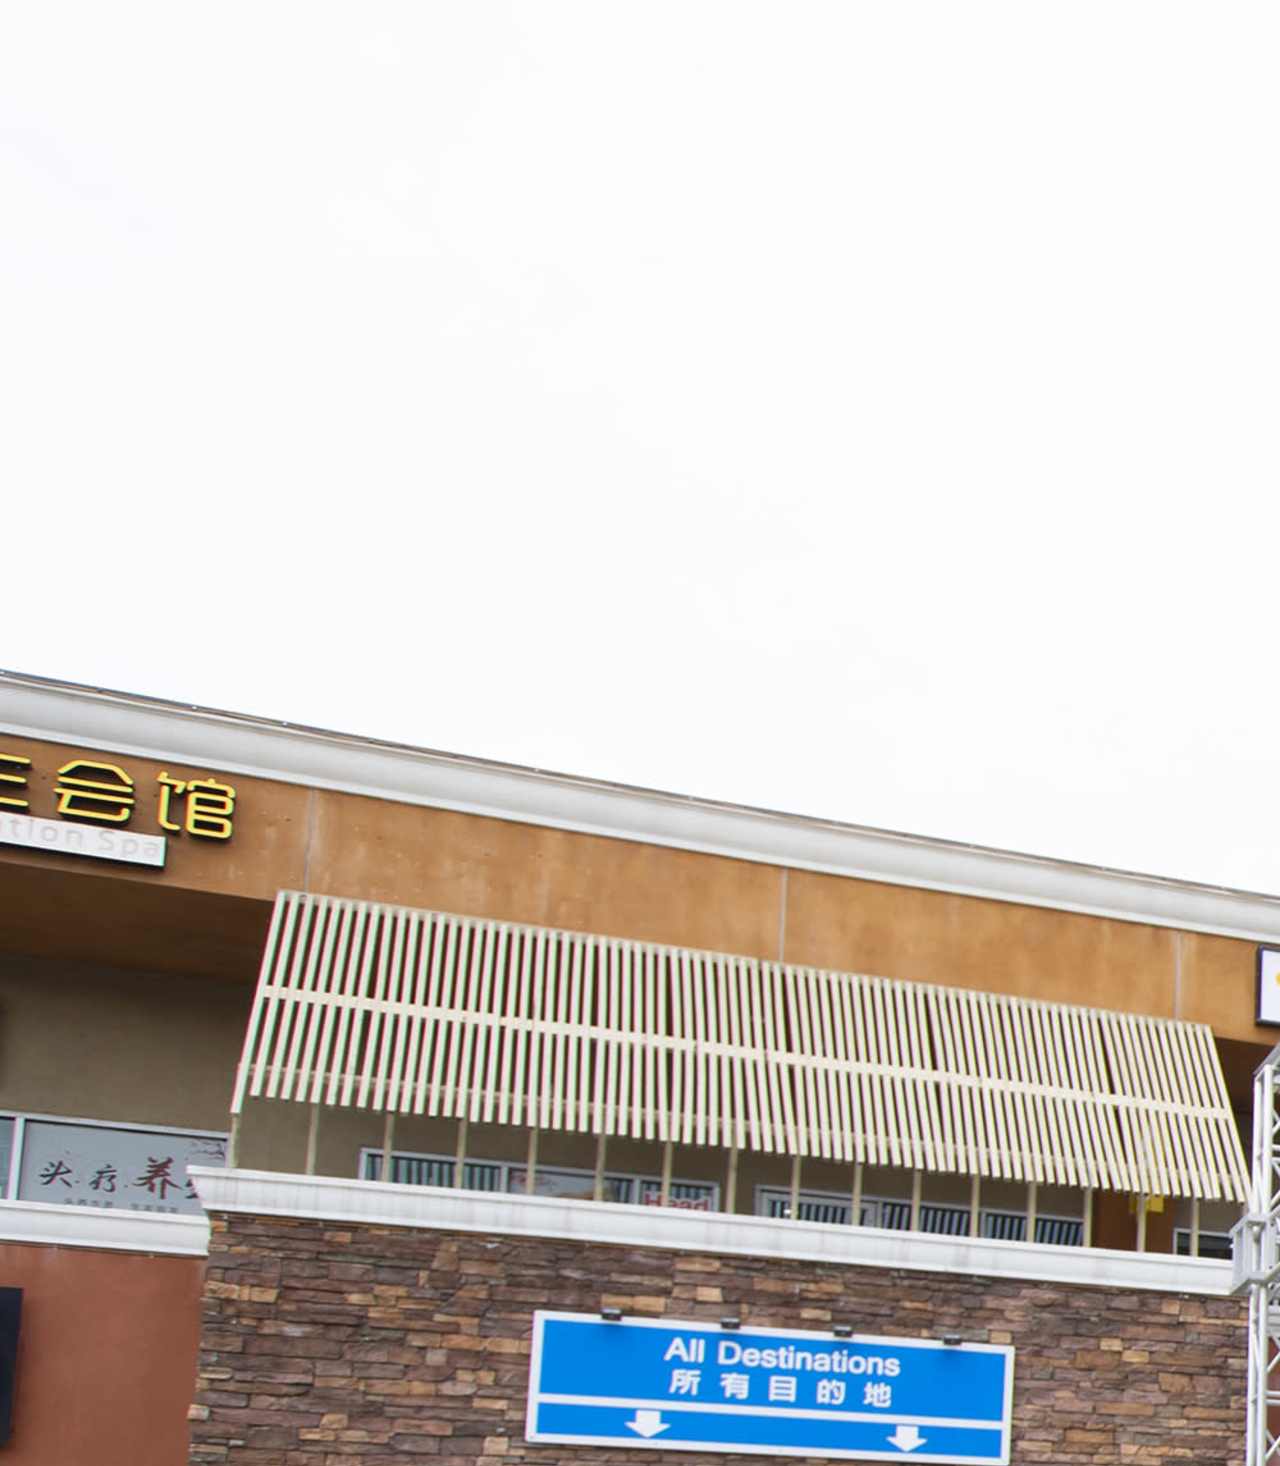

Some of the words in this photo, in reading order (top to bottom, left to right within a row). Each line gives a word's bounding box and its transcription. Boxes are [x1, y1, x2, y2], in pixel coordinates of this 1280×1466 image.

[664, 1337, 705, 1364] All
[717, 1340, 901, 1377] Destinations
[669, 1369, 892, 1408] 所有目的地
